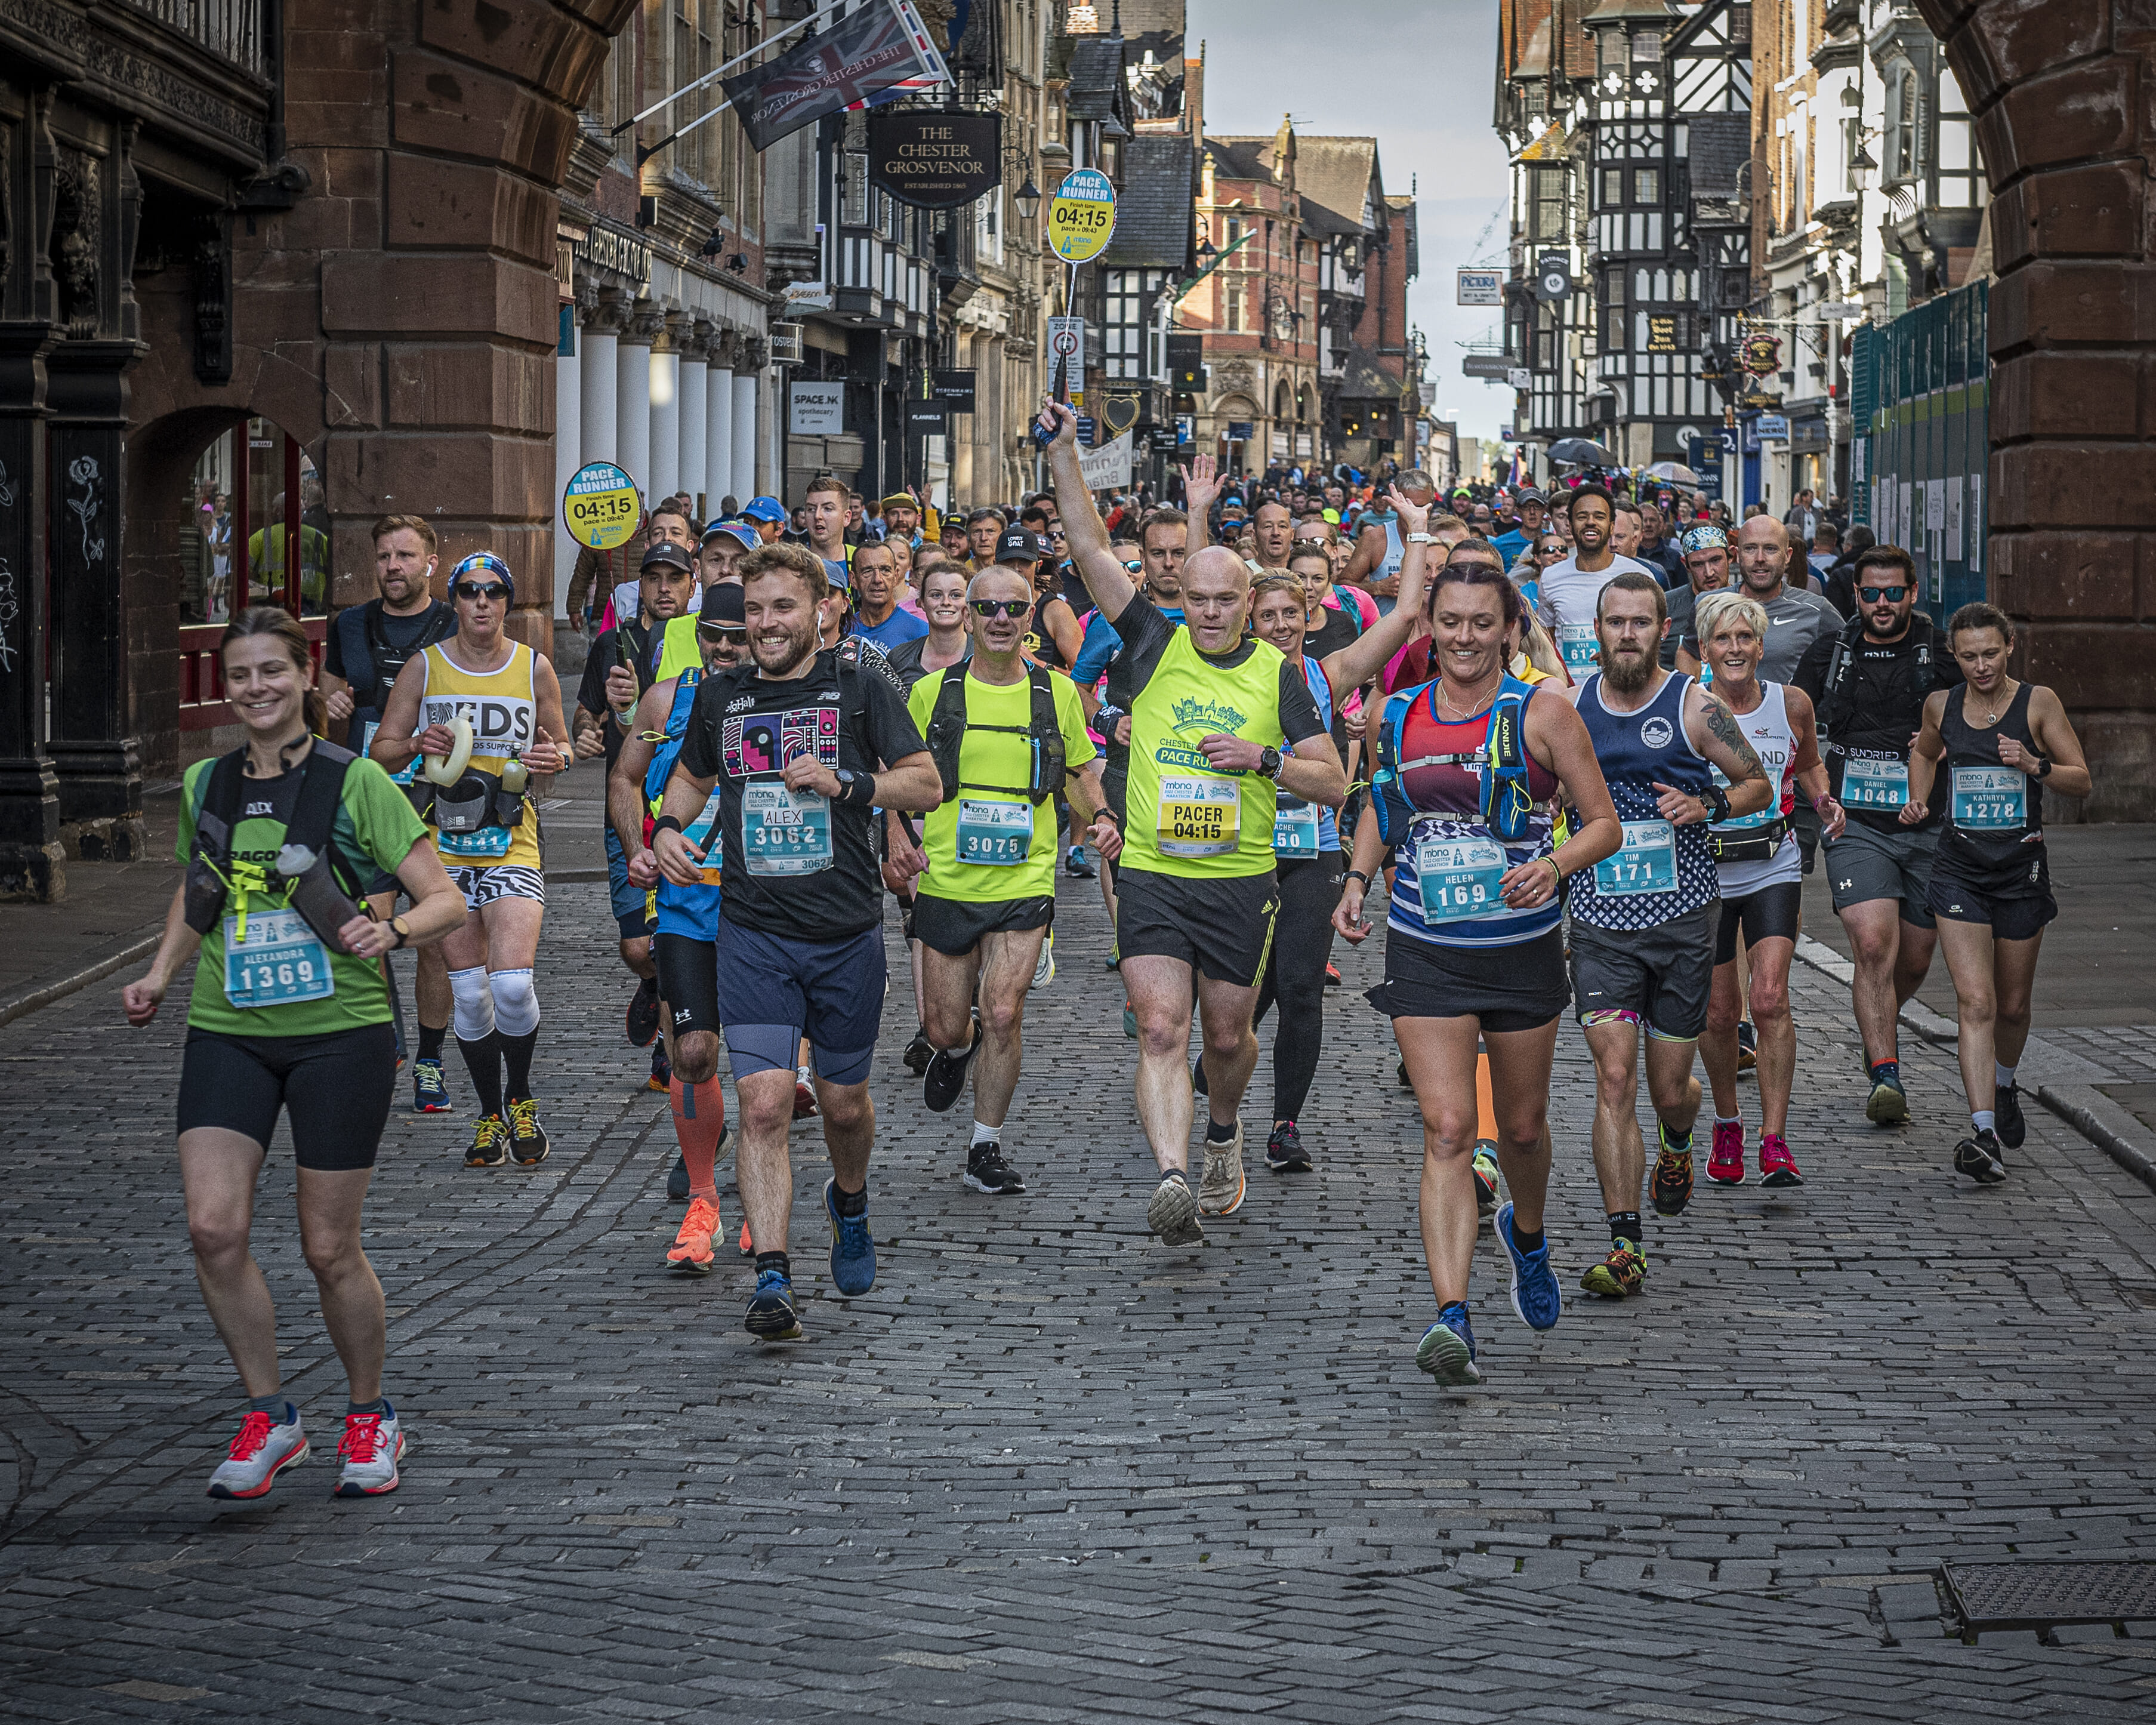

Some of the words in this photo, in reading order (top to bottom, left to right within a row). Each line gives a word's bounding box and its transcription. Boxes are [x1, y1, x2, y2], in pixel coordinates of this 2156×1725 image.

[918, 127, 952, 139] THE
[899, 144, 971, 156] CHESTER
[885, 161, 985, 174] GROSVENOR
[1072, 176, 1102, 187] PACE
[1062, 187, 1108, 201] RUNNER
[1056, 207, 1106, 227] 04:15
[798, 408, 834, 417] apothecary
[581, 468, 615, 482] PACE
[573, 478, 625, 494] RUNNER
[573, 497, 631, 519] 04:15
[1571, 648, 1596, 661] 612
[1161, 750, 1191, 764] PACE
[1850, 747, 1899, 760] SUNDRIED
[749, 790, 774, 799] mbna
[1853, 787, 1898, 803] 1048
[765, 809, 801, 824] ALEX
[967, 805, 988, 814] mbna
[1174, 806, 1223, 822] PACER
[1965, 803, 2014, 818] 1278
[755, 826, 816, 845] 3062
[1174, 823, 1222, 839] 04:15
[451, 835, 498, 845] 1541
[968, 837, 1017, 853] 3075
[1424, 849, 1449, 858] mbna
[802, 859, 826, 869] 3062
[1445, 874, 1474, 884] HELEN
[1612, 862, 1652, 882] 171
[1438, 884, 1486, 907] 169
[243, 948, 306, 965] ALEXANDRA
[240, 960, 313, 990] 1369
